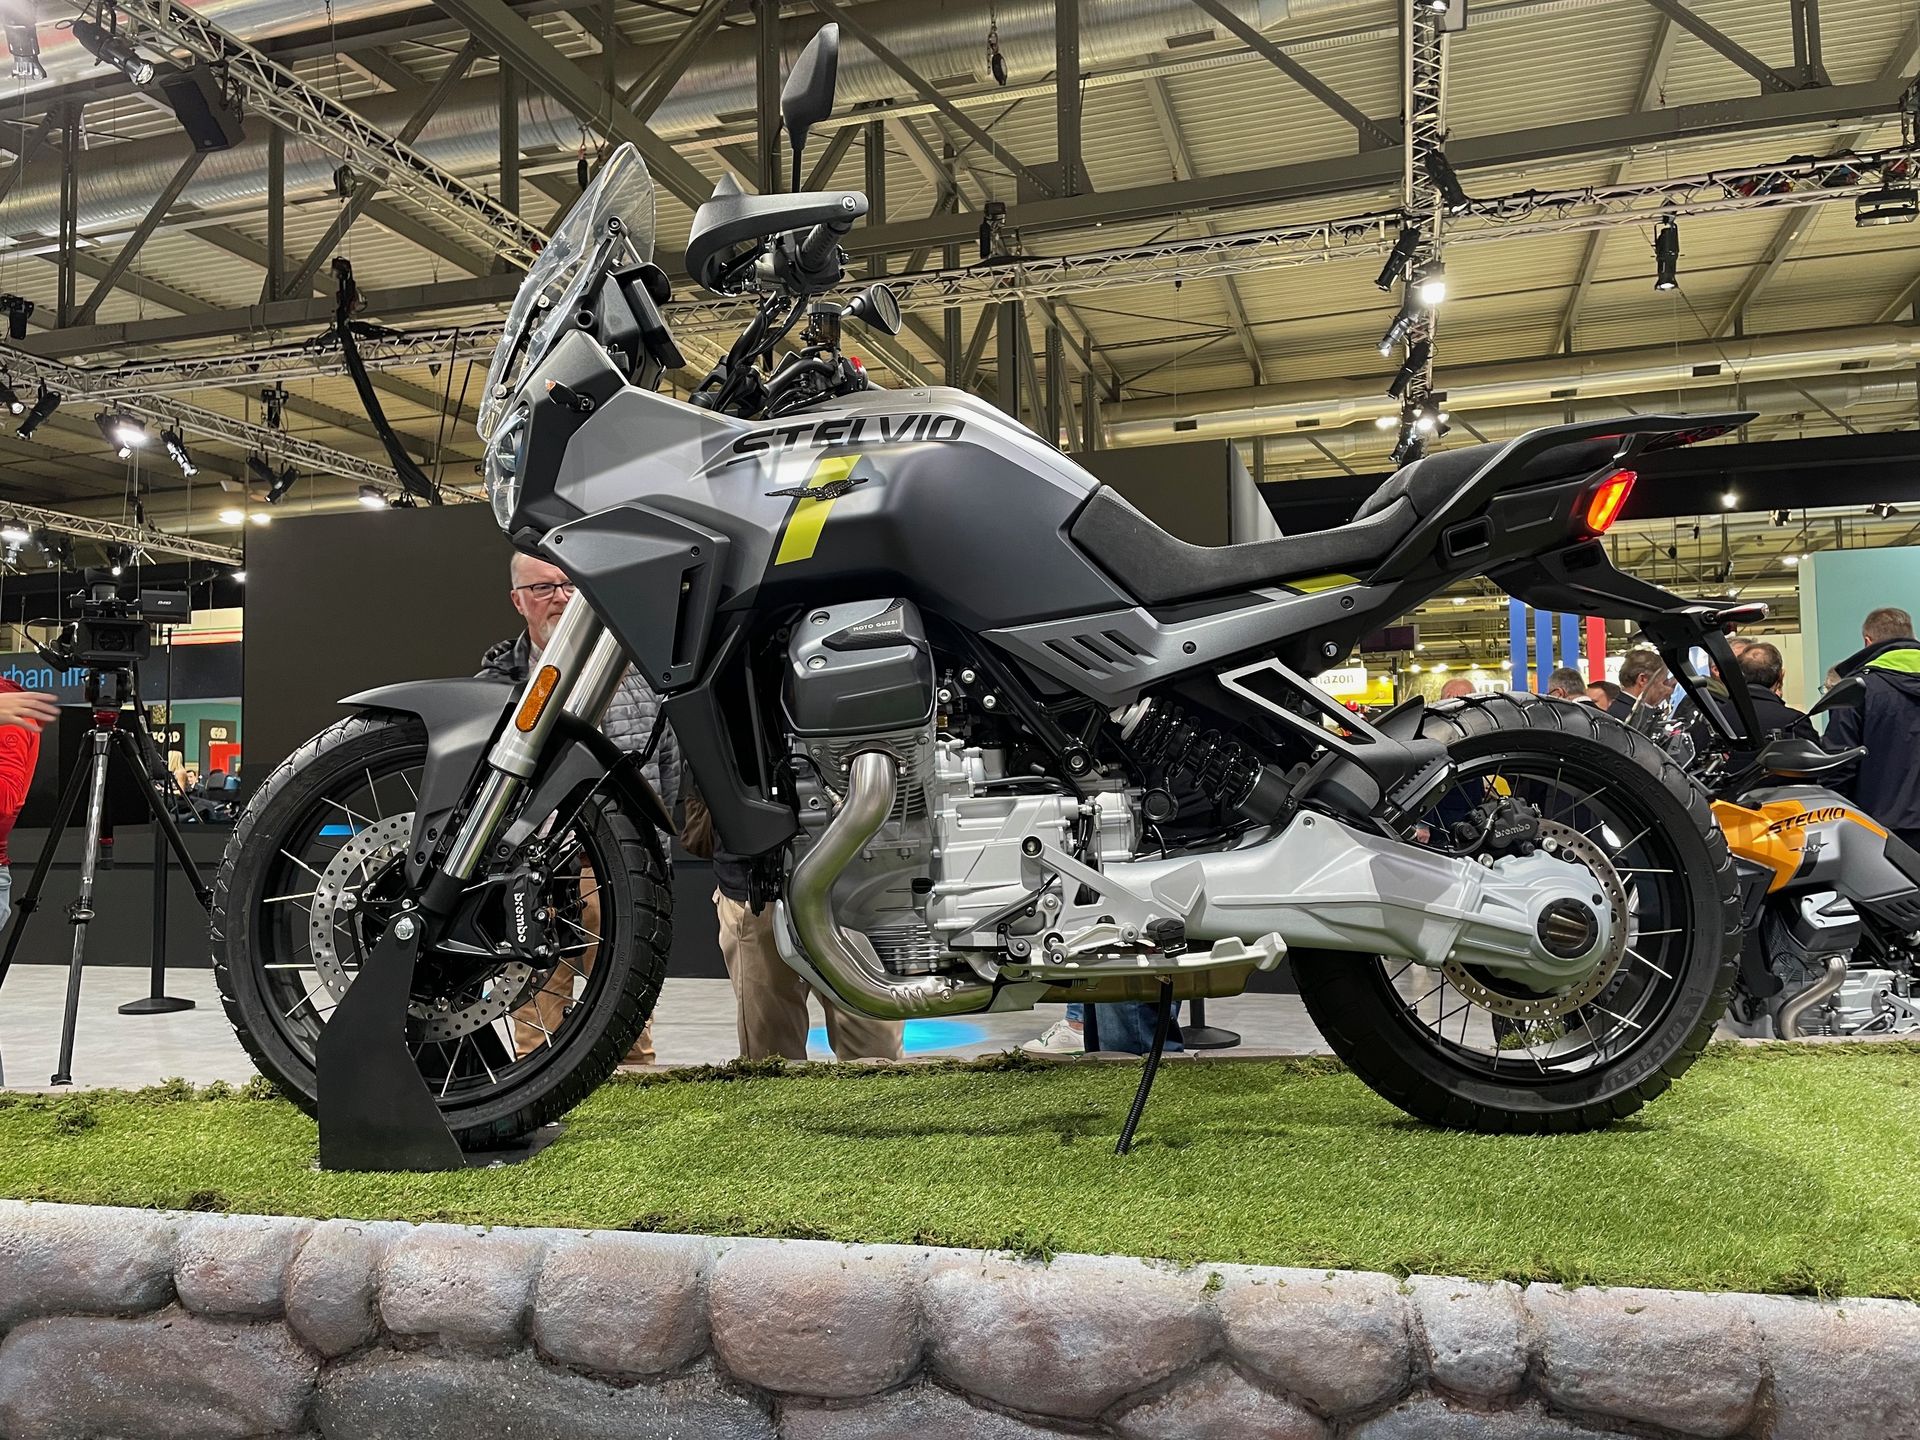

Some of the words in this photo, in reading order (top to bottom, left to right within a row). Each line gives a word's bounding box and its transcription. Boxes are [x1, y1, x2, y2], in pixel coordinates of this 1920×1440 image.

[732, 414, 966, 454] STELVIO
[853, 623, 874, 631] MOTO
[0, 664, 53, 689] rban
[1494, 823, 1531, 838] brembo
[1768, 807, 1846, 833] STELVIO
[513, 892, 529, 943] brembo
